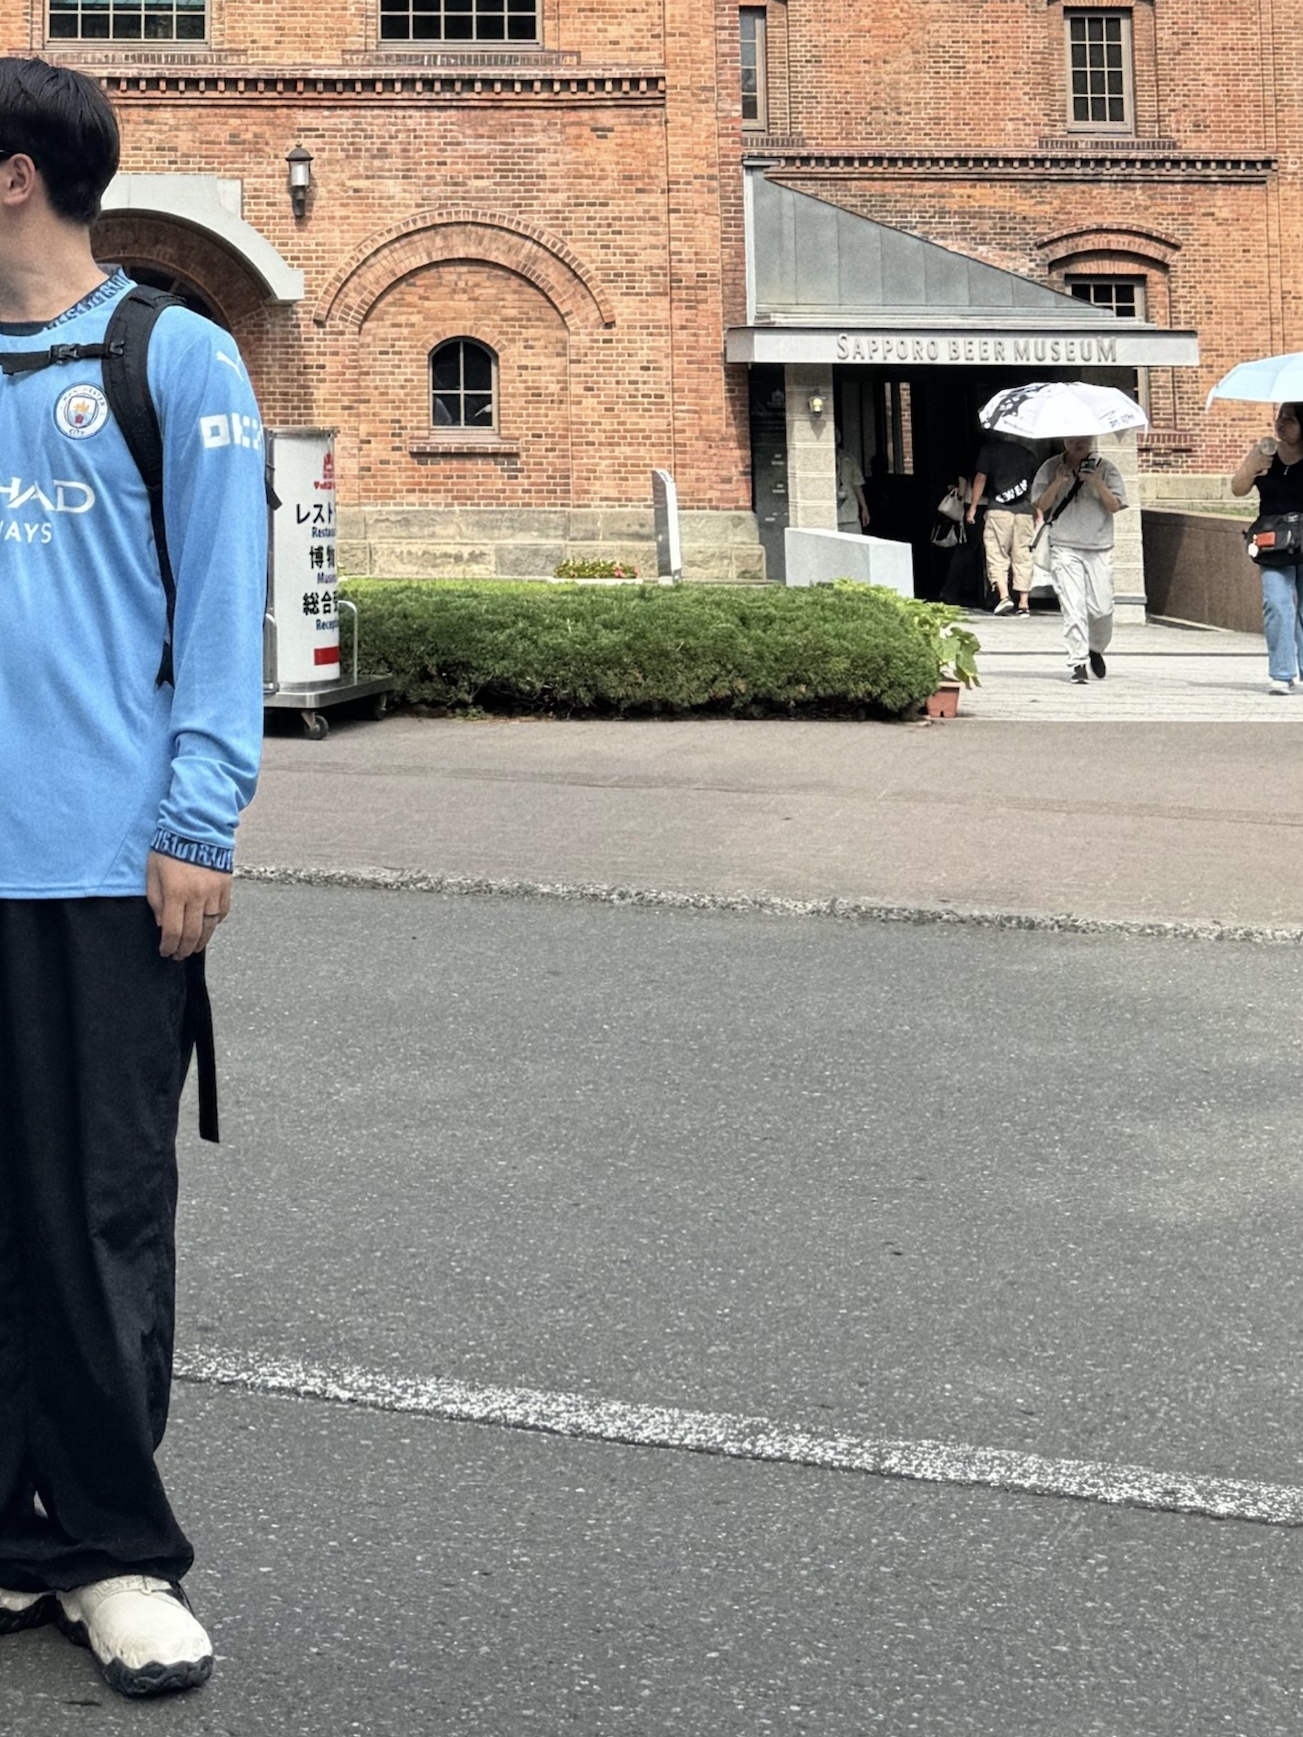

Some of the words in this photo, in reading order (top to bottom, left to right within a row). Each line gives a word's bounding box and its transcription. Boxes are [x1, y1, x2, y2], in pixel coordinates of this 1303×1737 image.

[837, 333, 939, 361] SAPPORO
[949, 340, 1005, 362] BEER
[1013, 337, 1117, 363] MUSEUM
[296, 502, 335, 524] レスト
